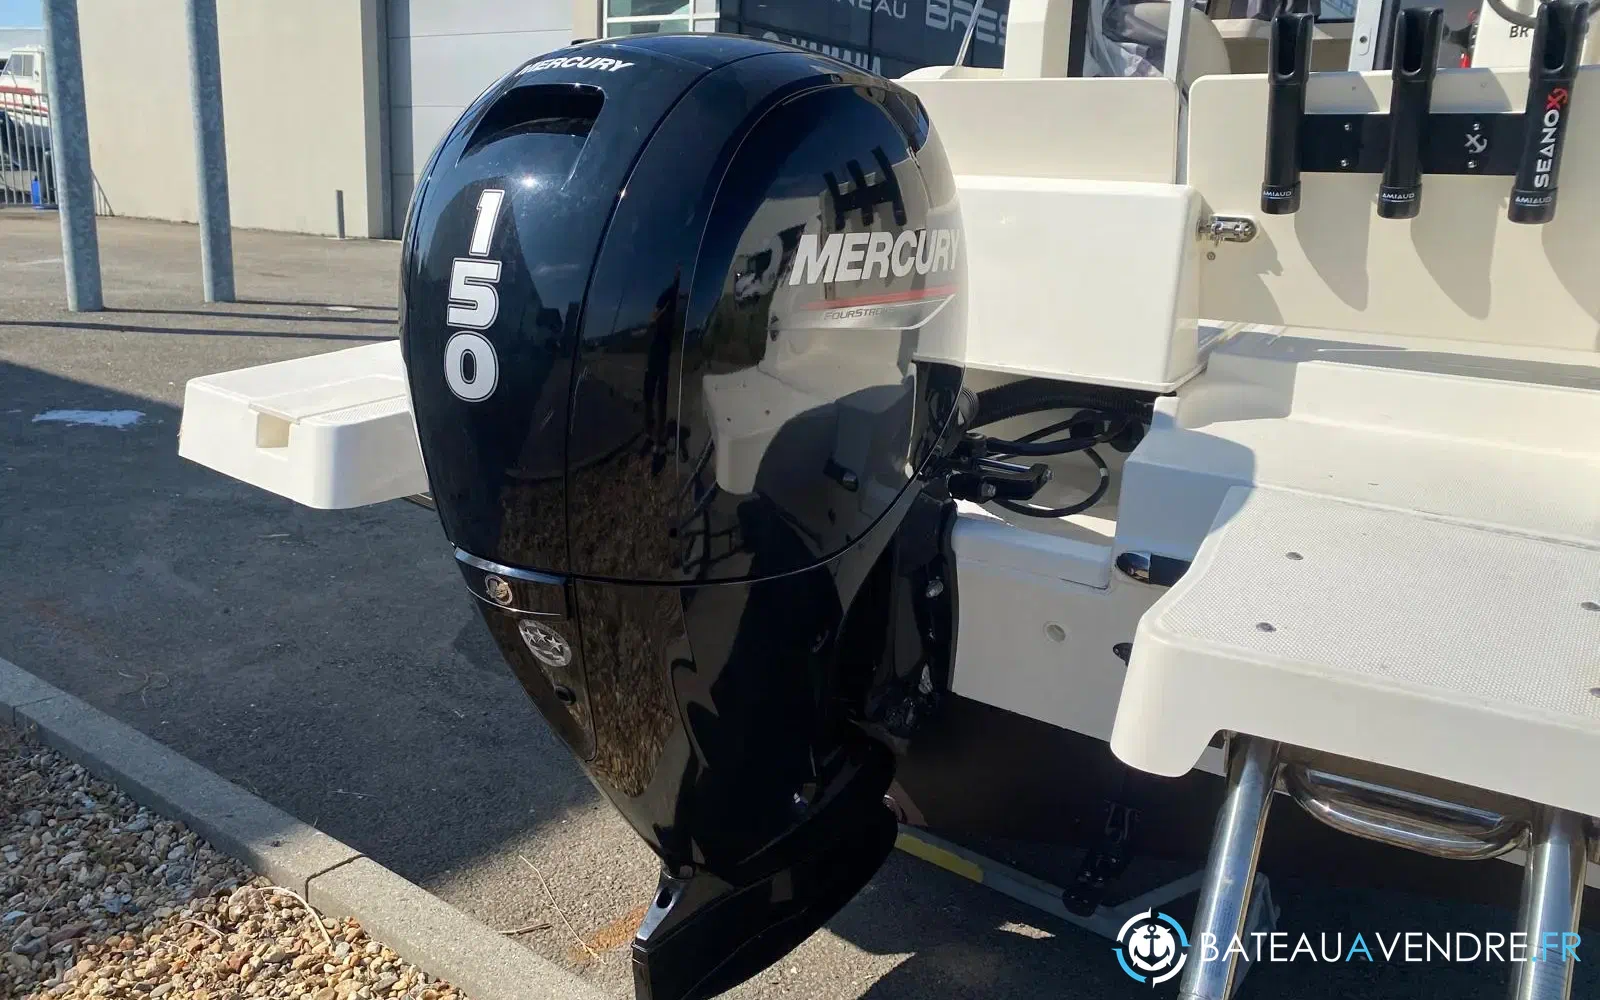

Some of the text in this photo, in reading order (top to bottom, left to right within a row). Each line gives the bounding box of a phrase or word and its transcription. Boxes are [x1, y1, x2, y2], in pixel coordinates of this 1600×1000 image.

[514, 56, 635, 78] MERCURY
[1534, 88, 1568, 188] SEANOX
[1382, 192, 1415, 200] AMIAUD
[789, 228, 960, 286] MERCURY
[444, 188, 505, 402] 150
